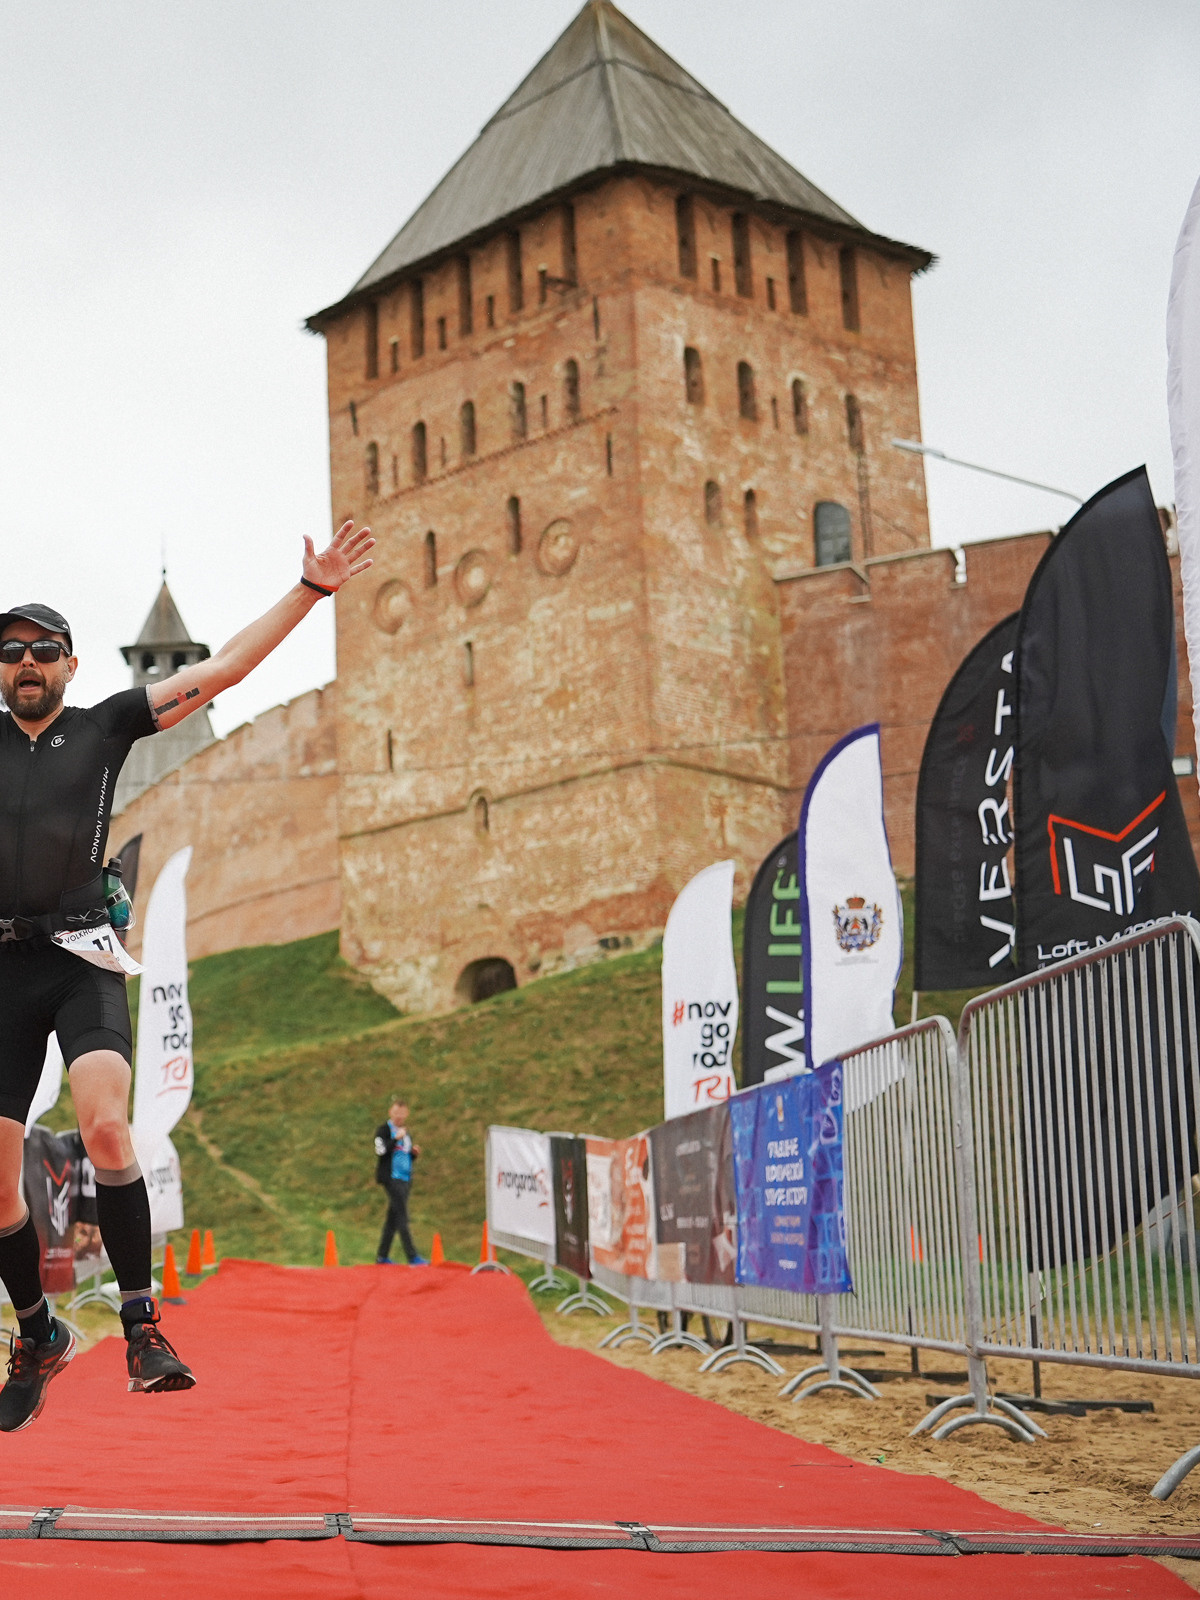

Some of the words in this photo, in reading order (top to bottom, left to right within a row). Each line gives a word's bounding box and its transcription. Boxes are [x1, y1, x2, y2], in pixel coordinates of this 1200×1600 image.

[98, 766, 109, 817] MIKHAIL
[90, 820, 103, 863] IVANOV
[92, 934, 114, 954] 17
[1037, 939, 1090, 960] Loft
[673, 1001, 732, 1027] #nov
[701, 1023, 730, 1048] go
[693, 1041, 730, 1069] rod
